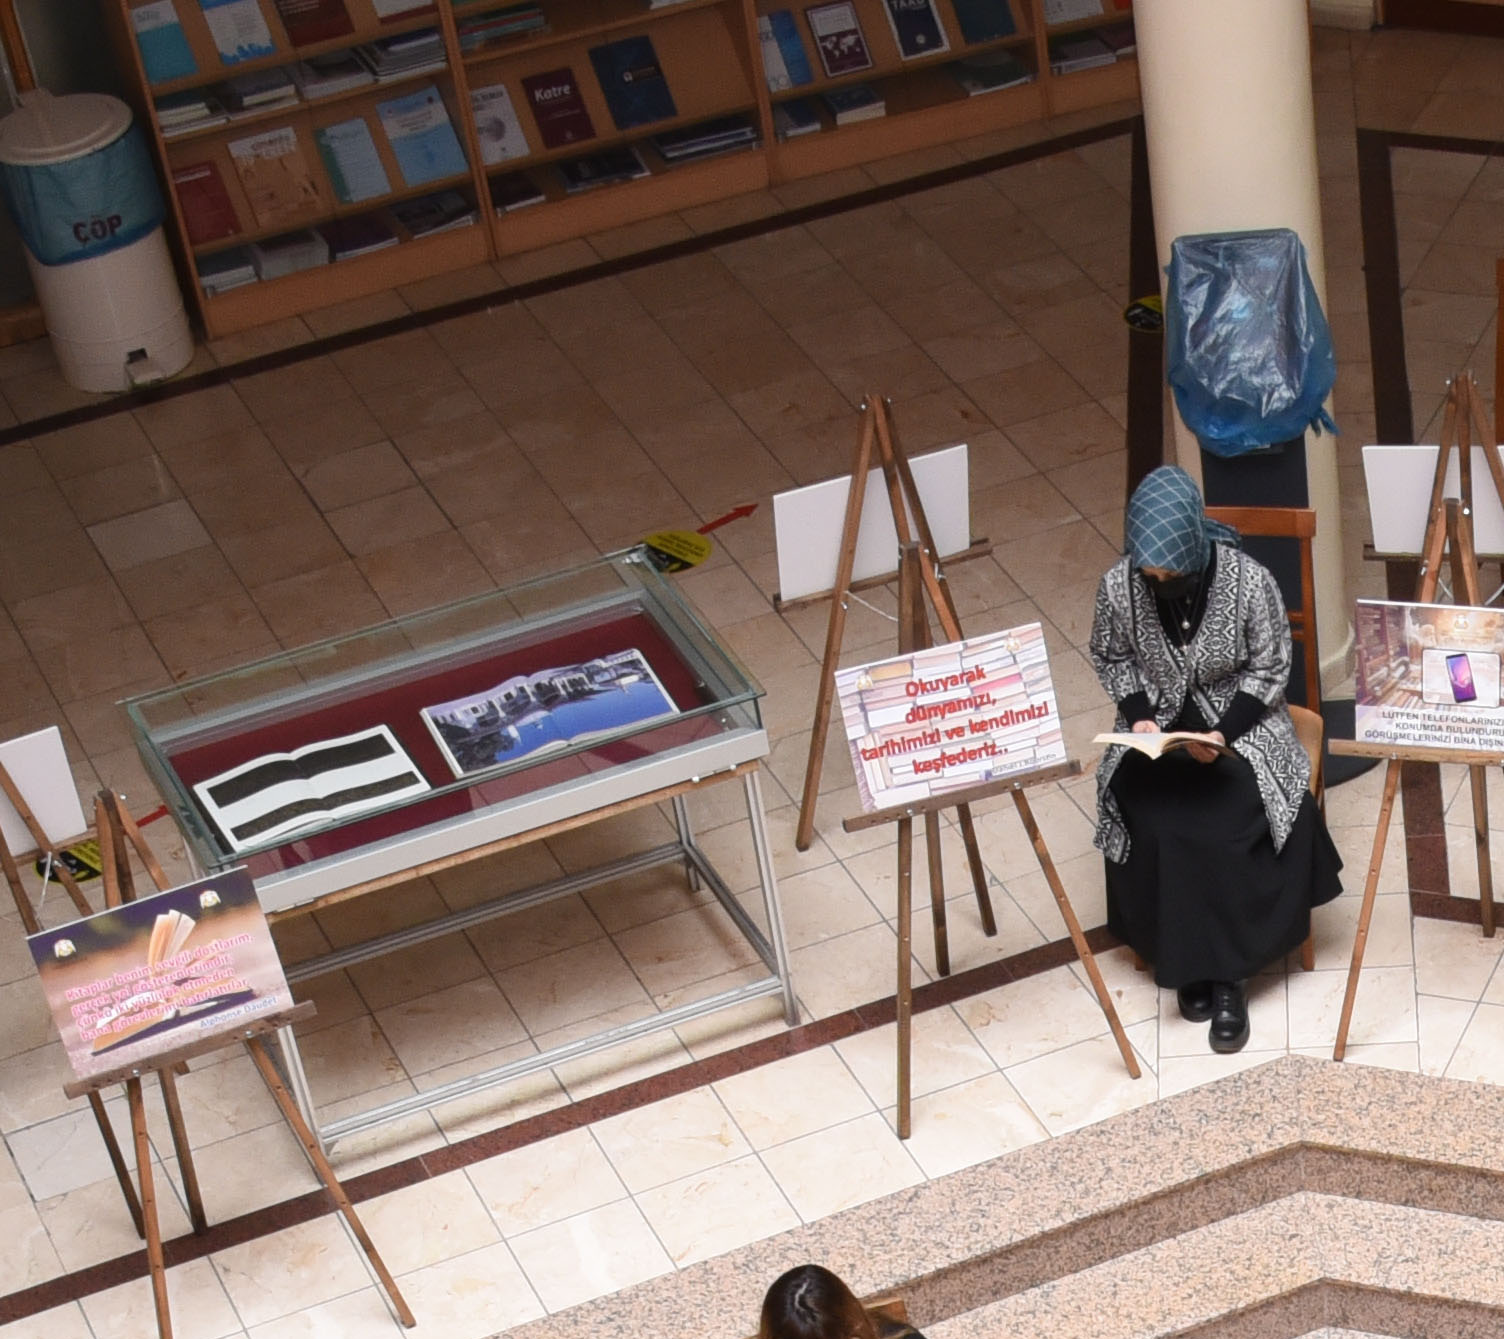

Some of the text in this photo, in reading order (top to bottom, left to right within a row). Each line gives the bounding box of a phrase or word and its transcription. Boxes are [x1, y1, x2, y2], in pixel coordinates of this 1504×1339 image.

[535, 84, 571, 101] Katre
[903, 663, 986, 700] Okuyarak
[860, 700, 1049, 762] tarihimizi ve kendimizi
[1395, 720, 1442, 732] KONUMDA
[64, 975, 115, 1004] Kitaplar
[114, 962, 154, 986] benim
[199, 995, 277, 1030] Alphonse Daudet
[79, 1022, 111, 1041] bana
